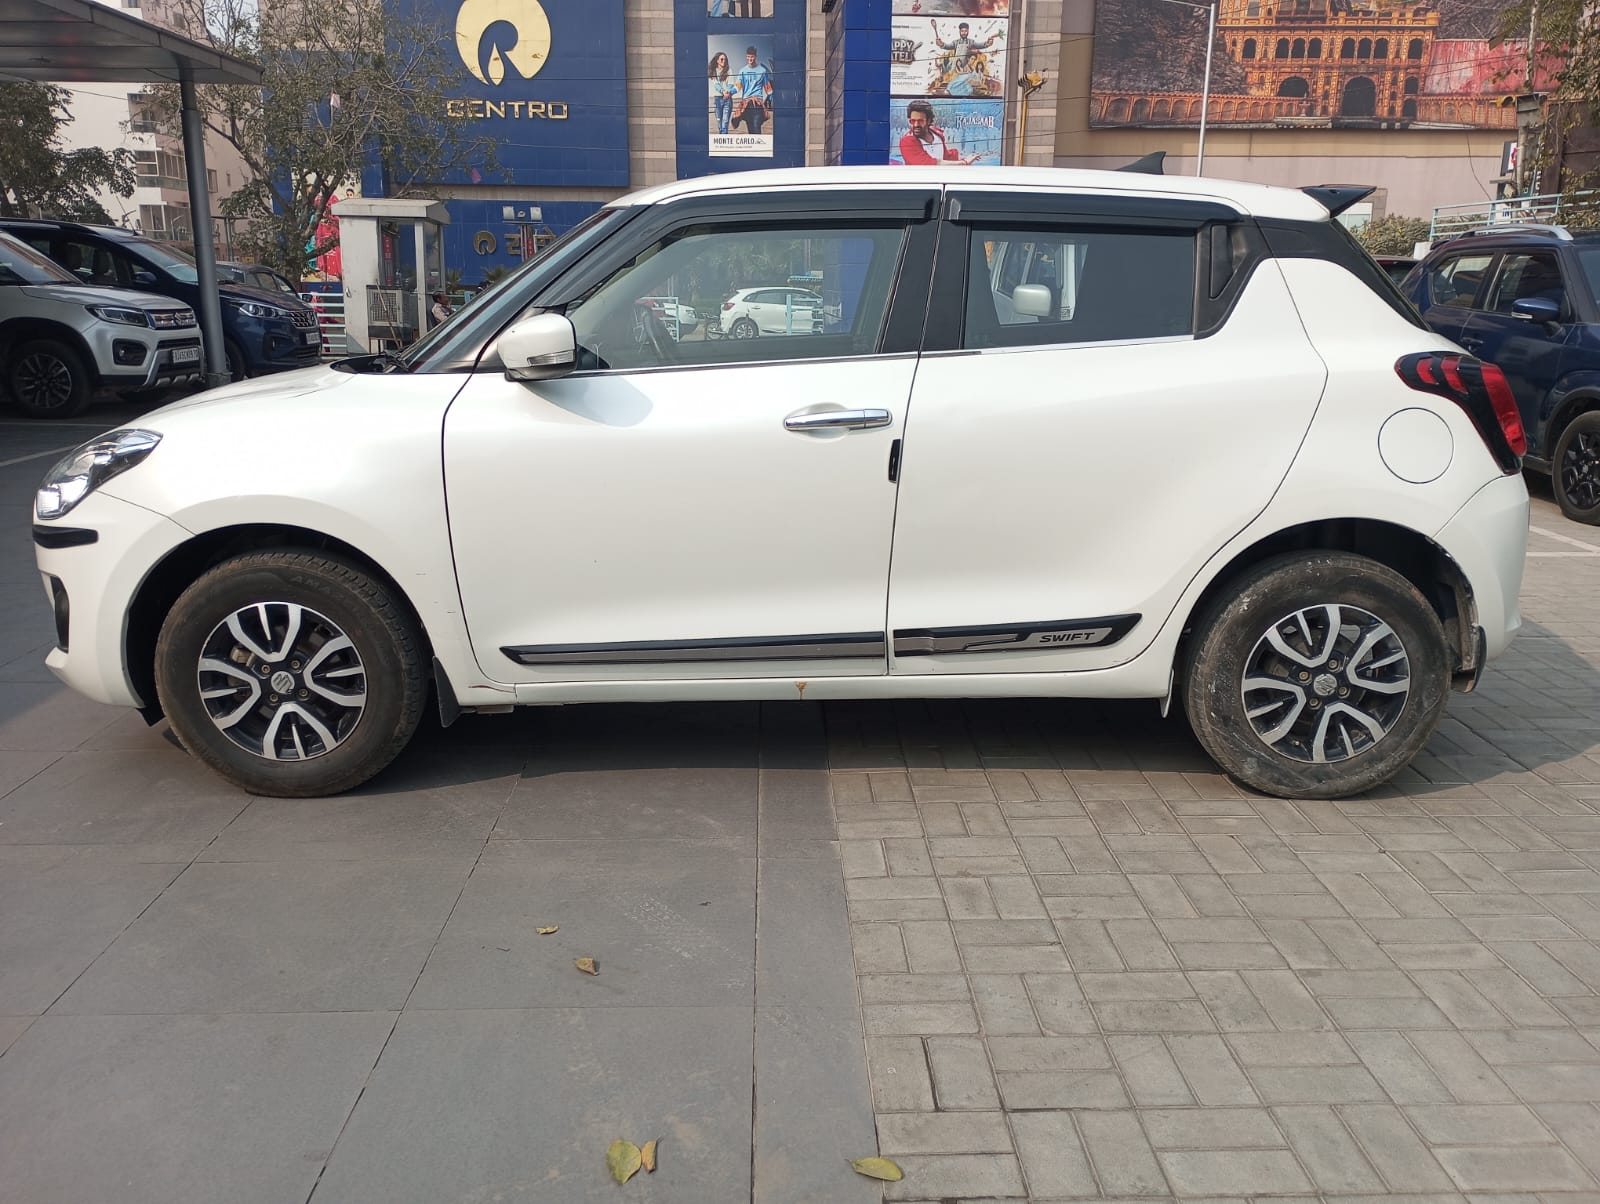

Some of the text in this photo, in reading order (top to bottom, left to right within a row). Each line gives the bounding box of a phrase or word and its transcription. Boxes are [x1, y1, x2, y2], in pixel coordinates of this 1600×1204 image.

[892, 40, 913, 51] PPY
[446, 100, 568, 119] CENTRO
[713, 137, 755, 145] MONTE CARLO
[1039, 632, 1096, 643] SWIFT
